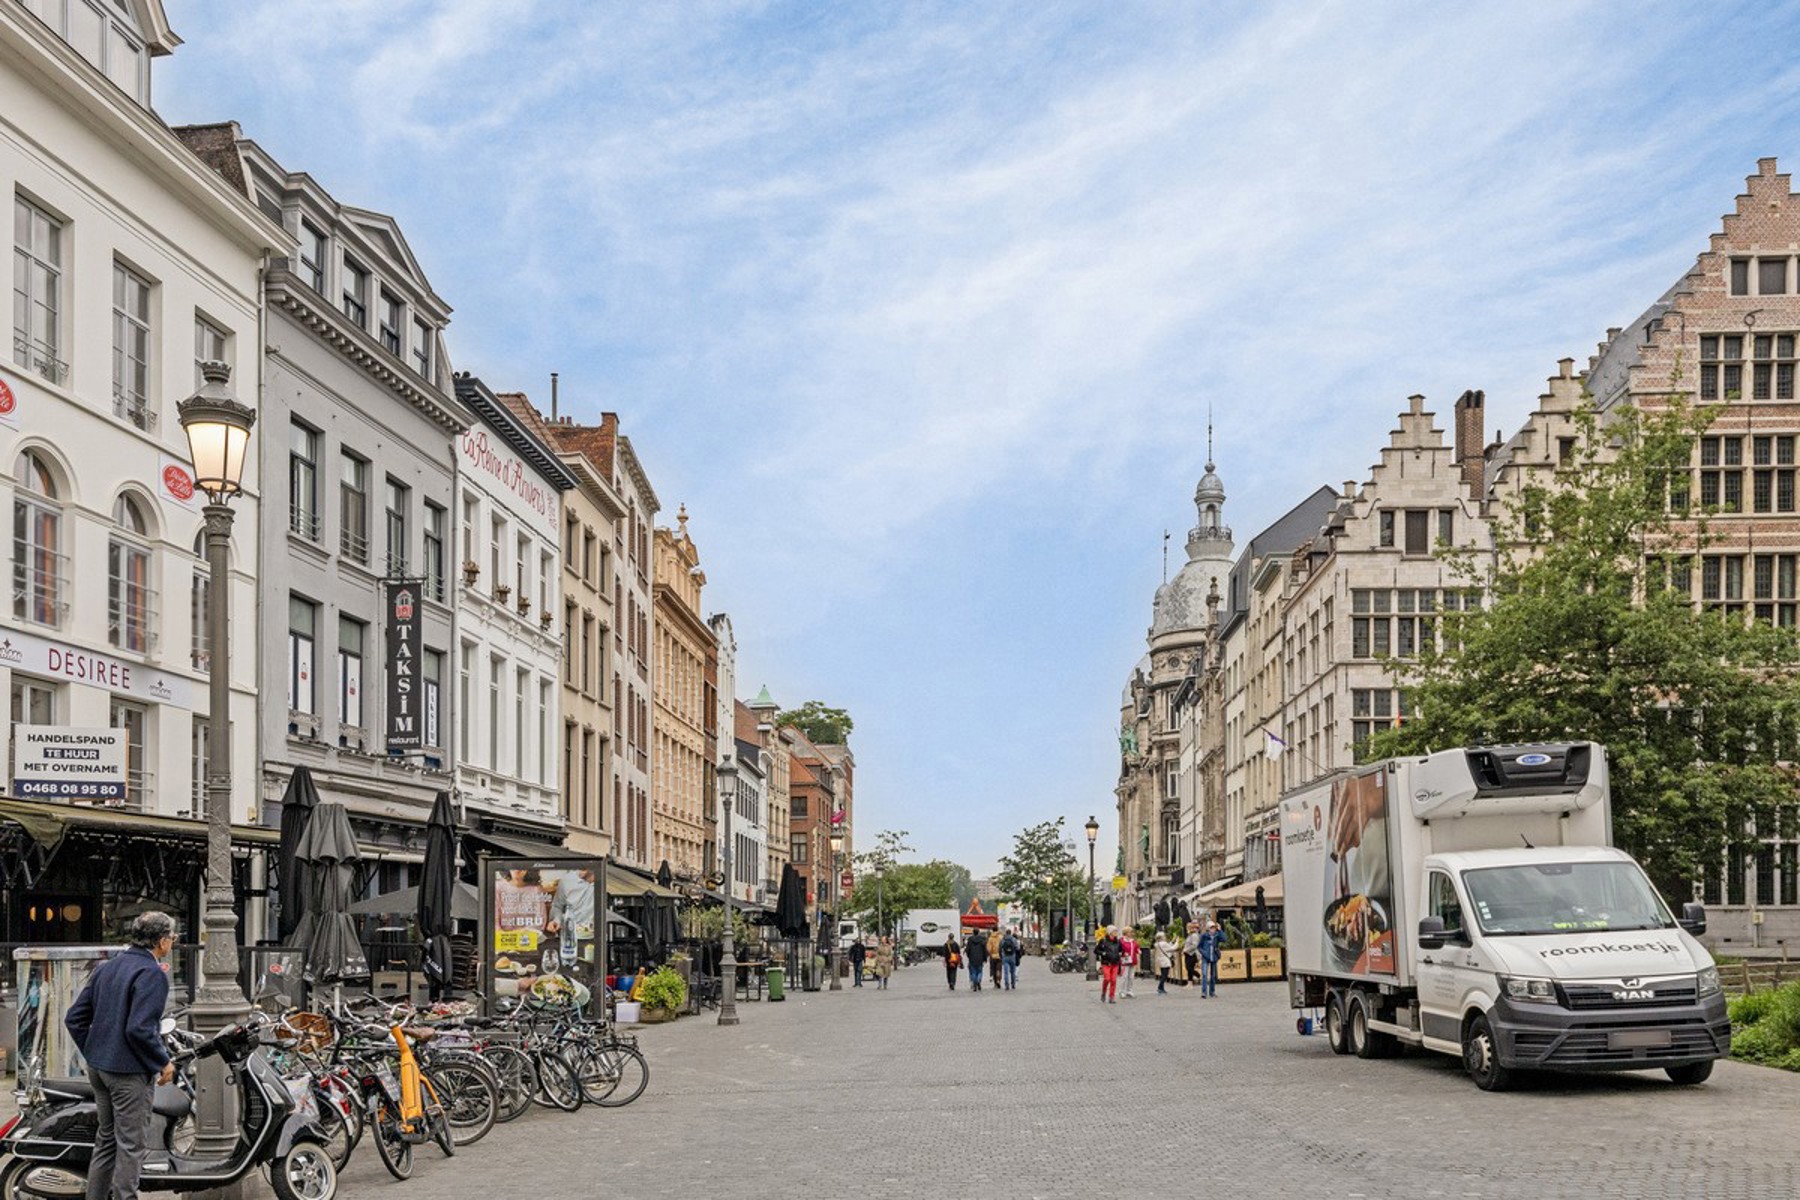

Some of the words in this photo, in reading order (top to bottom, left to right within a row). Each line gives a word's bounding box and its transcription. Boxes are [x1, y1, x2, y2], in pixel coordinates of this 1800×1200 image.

[475, 431, 502, 481] Reine
[49, 648, 130, 689] DÉSIRÉE
[27, 734, 116, 745] HANDELSPAND
[388, 735, 420, 745] restaurant
[46, 749, 61, 758] TE
[64, 750, 97, 759] HUUR
[24, 763, 48, 772] MET
[52, 763, 118, 774] OVERNAME
[23, 783, 58, 794] 0468
[61, 784, 78, 794] 08
[81, 785, 97, 795] 95
[100, 785, 118, 795] 80
[1540, 941, 1680, 958] roomkoetje
[1612, 990, 1654, 1000] MAN
